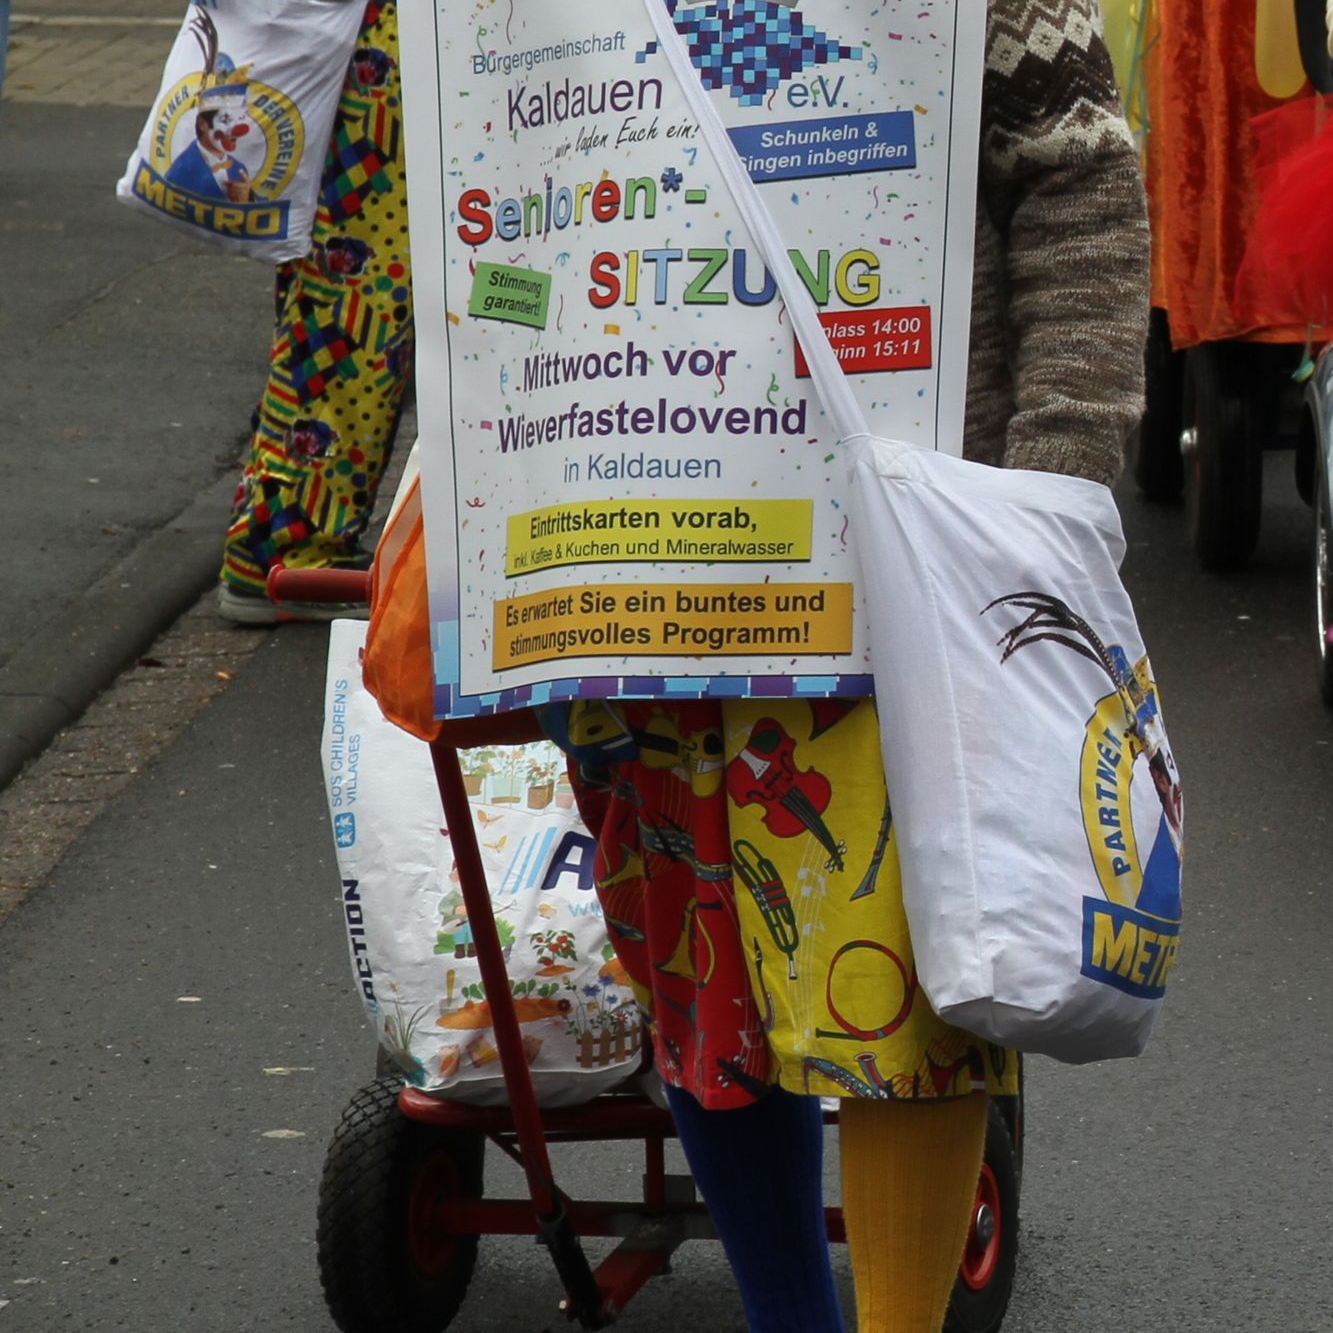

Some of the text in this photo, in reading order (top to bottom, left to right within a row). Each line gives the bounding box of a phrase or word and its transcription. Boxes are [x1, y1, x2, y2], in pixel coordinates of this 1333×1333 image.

[473, 31, 627, 75] Bürgergemeinschaft
[507, 75, 849, 132] Kaldauen e.V.
[155, 85, 296, 191] PARTNER DER VEREINE
[575, 125, 608, 152] laden
[616, 116, 659, 145] Euch
[666, 118, 700, 139] ein!
[760, 122, 878, 148] Schunkeln &
[807, 144, 908, 167] inbegriffen
[135, 167, 282, 236] METRO
[488, 270, 543, 299] Stimmung
[587, 248, 882, 309] SITZUNG
[483, 293, 542, 317] garantiert!
[824, 317, 921, 339] nlass 14:00
[873, 339, 921, 357] 15:11
[523, 341, 737, 393] Mittwoch vor
[498, 398, 807, 454] Wieverfastelovend
[564, 452, 722, 483] in Kaldauen
[530, 507, 757, 540] Eintrittskarten vorab,
[530, 546, 553, 564] Kaffee
[555, 543, 563, 559] &
[565, 541, 620, 557] Kuchen
[625, 539, 660, 555] und
[666, 538, 794, 556] Mineralwasser
[506, 590, 826, 627] Es erwartet Sie ein buntes und
[510, 621, 811, 658] stimmungsvolles Programm!
[330, 678, 349, 808] SOS CHILDREN'S
[346, 733, 361, 806] VILLAGES
[342, 879, 378, 1004] ACTION
